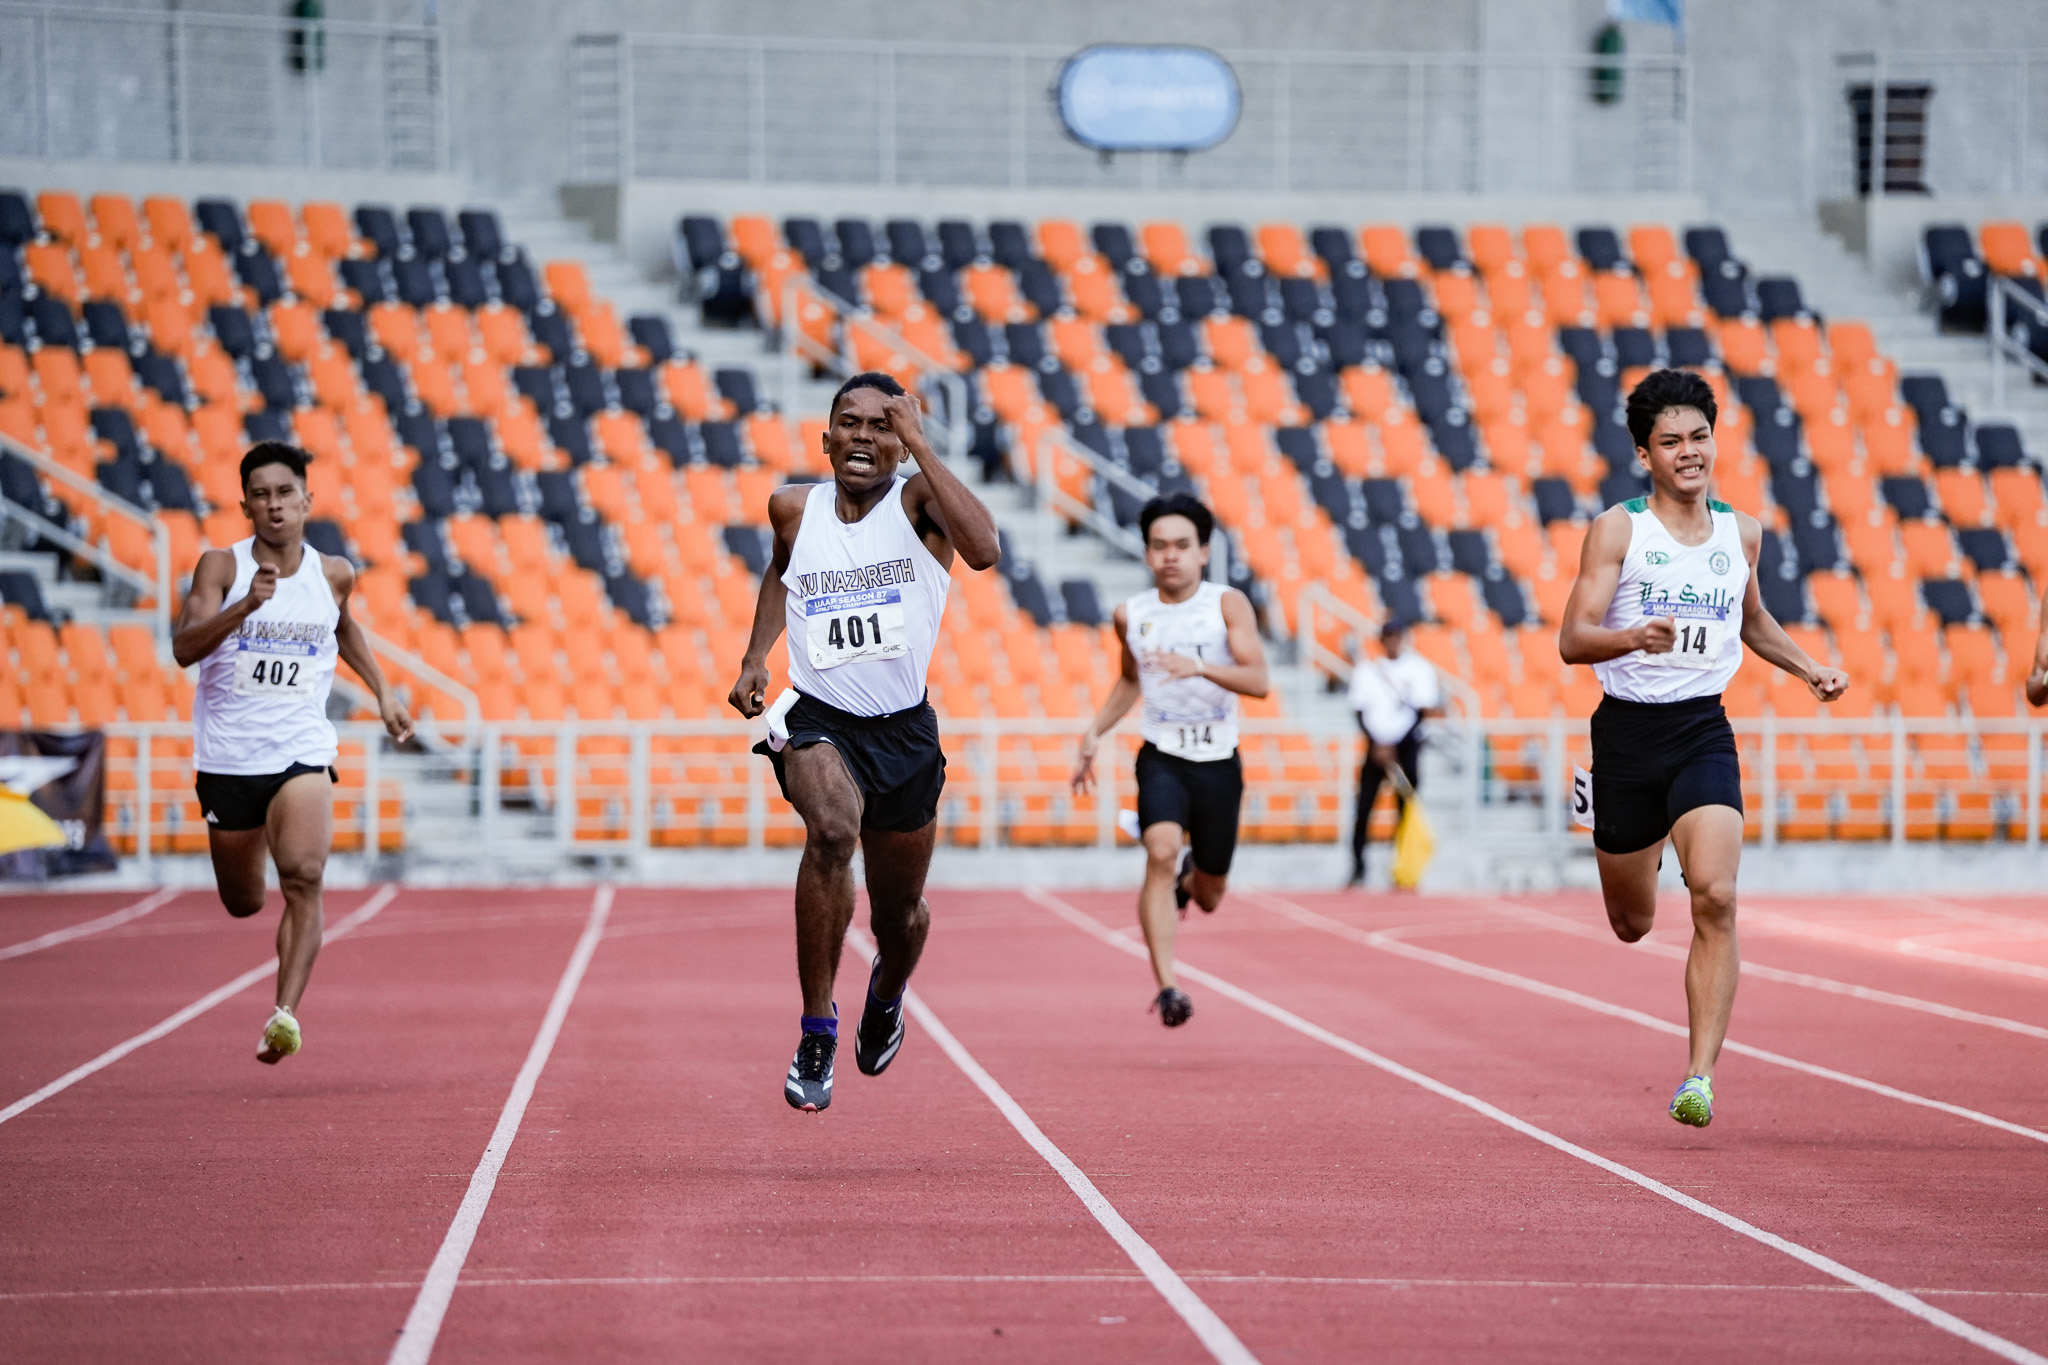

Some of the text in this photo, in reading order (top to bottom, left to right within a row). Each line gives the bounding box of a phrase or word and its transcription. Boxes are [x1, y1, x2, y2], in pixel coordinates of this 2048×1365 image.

[797, 558, 915, 598] NU NAZARETH
[814, 590, 888, 608] UAAP SEASON 87
[828, 612, 882, 650] 401
[1681, 625, 1707, 654] 14
[252, 660, 299, 686] 402
[1179, 725, 1212, 748] 114
[1574, 775, 1589, 815] 5
